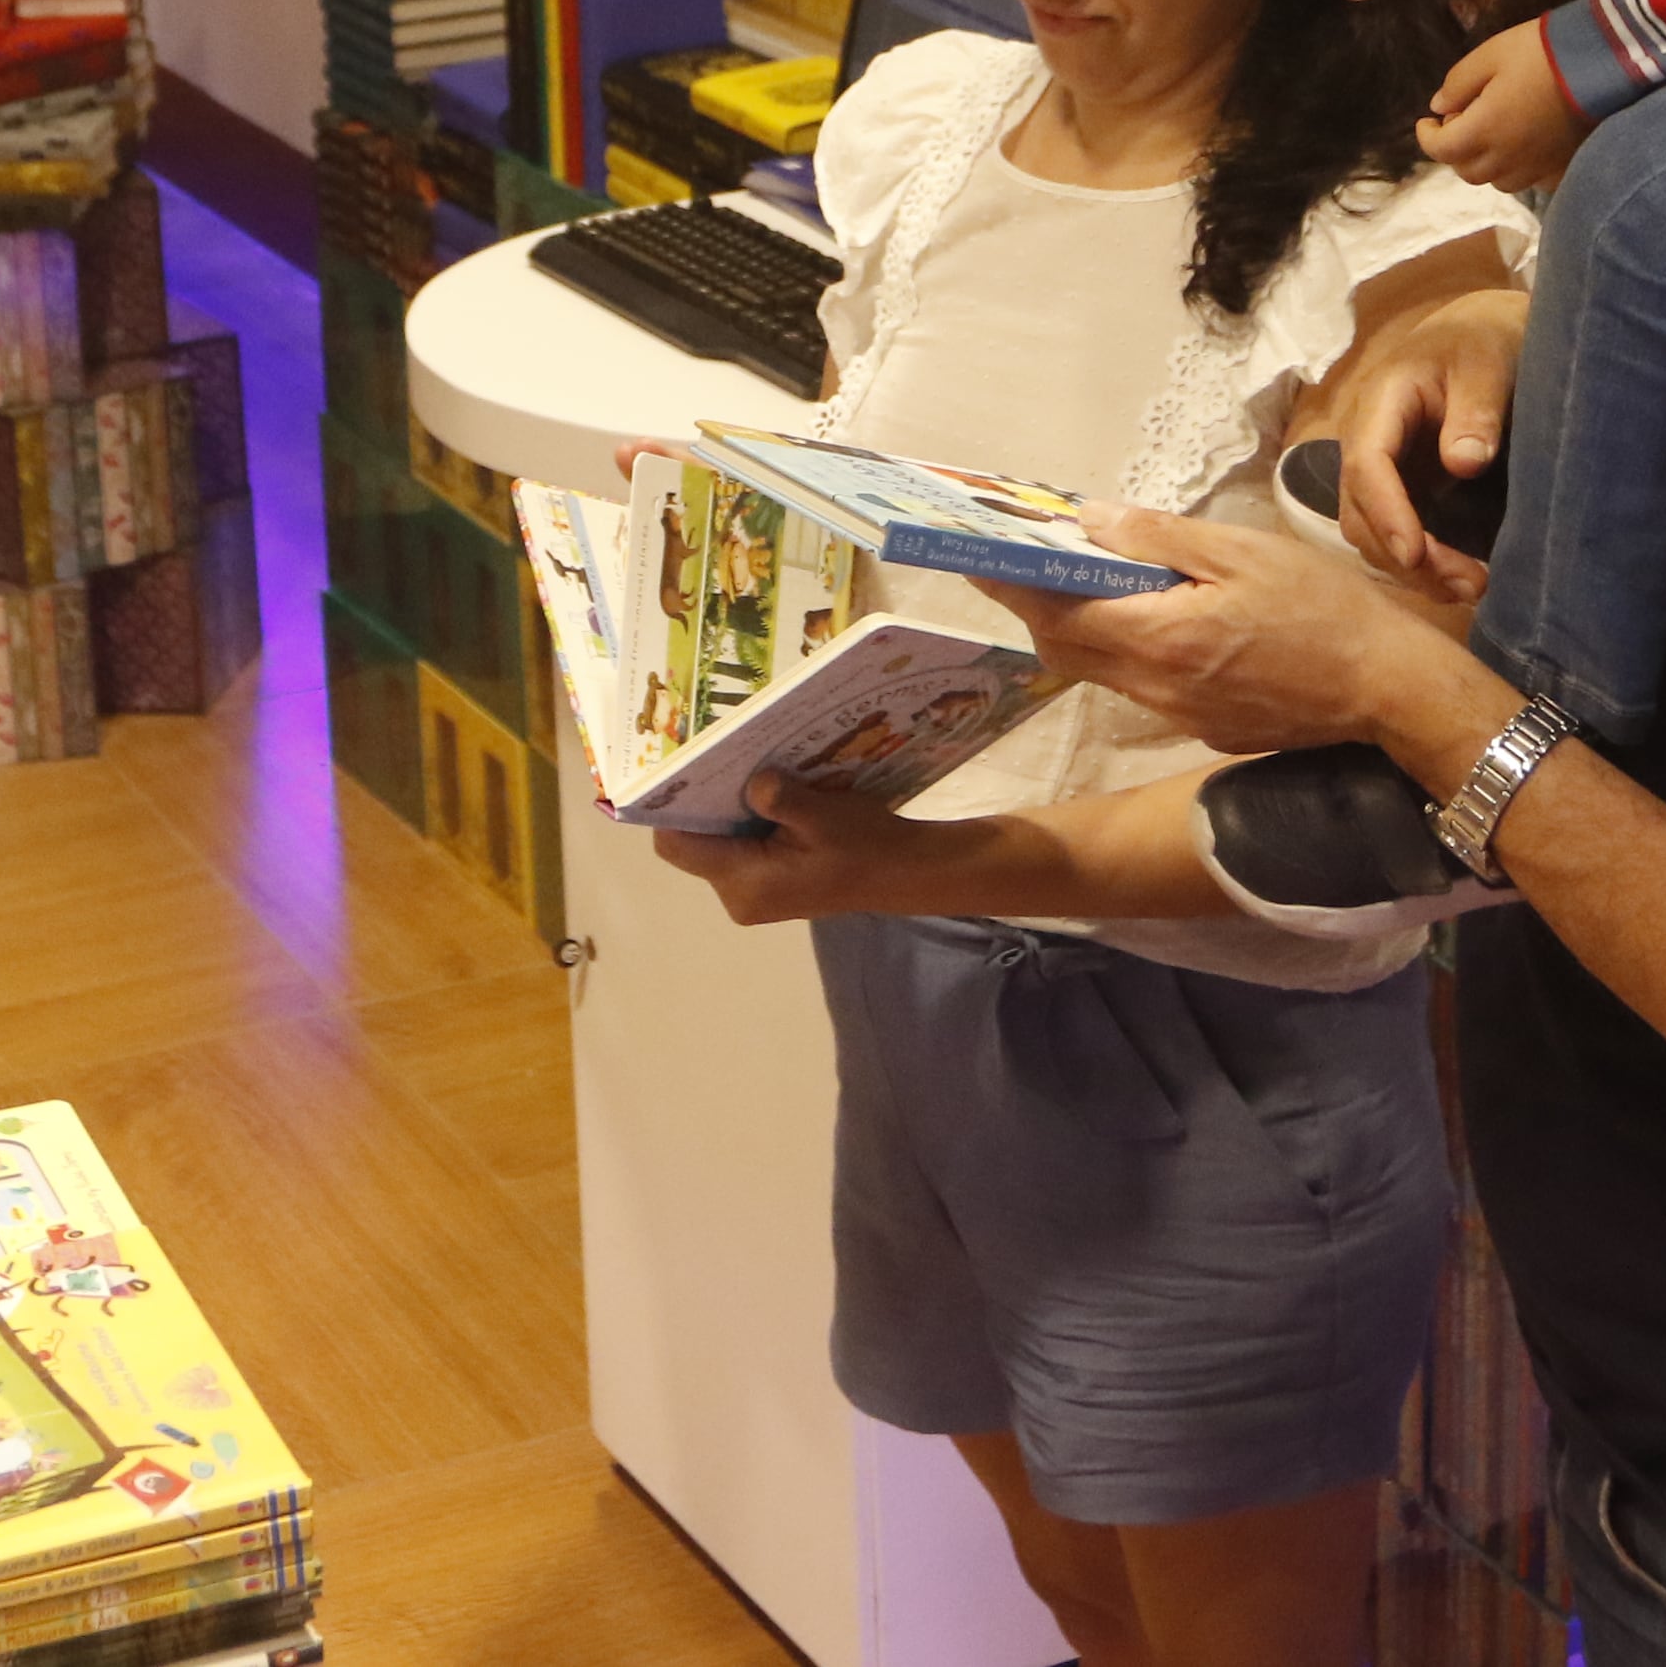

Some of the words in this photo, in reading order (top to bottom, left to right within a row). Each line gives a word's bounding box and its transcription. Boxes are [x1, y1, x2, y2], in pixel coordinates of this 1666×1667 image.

[927, 548, 975, 567] Questions
[1044, 558, 1070, 586] Why
[1073, 564, 1090, 582] do
[1093, 569, 1101, 583] I
[1104, 568, 1135, 590] have
[1138, 576, 1153, 592] to
[623, 707, 635, 779] Medicines
[632, 630, 640, 662] from
